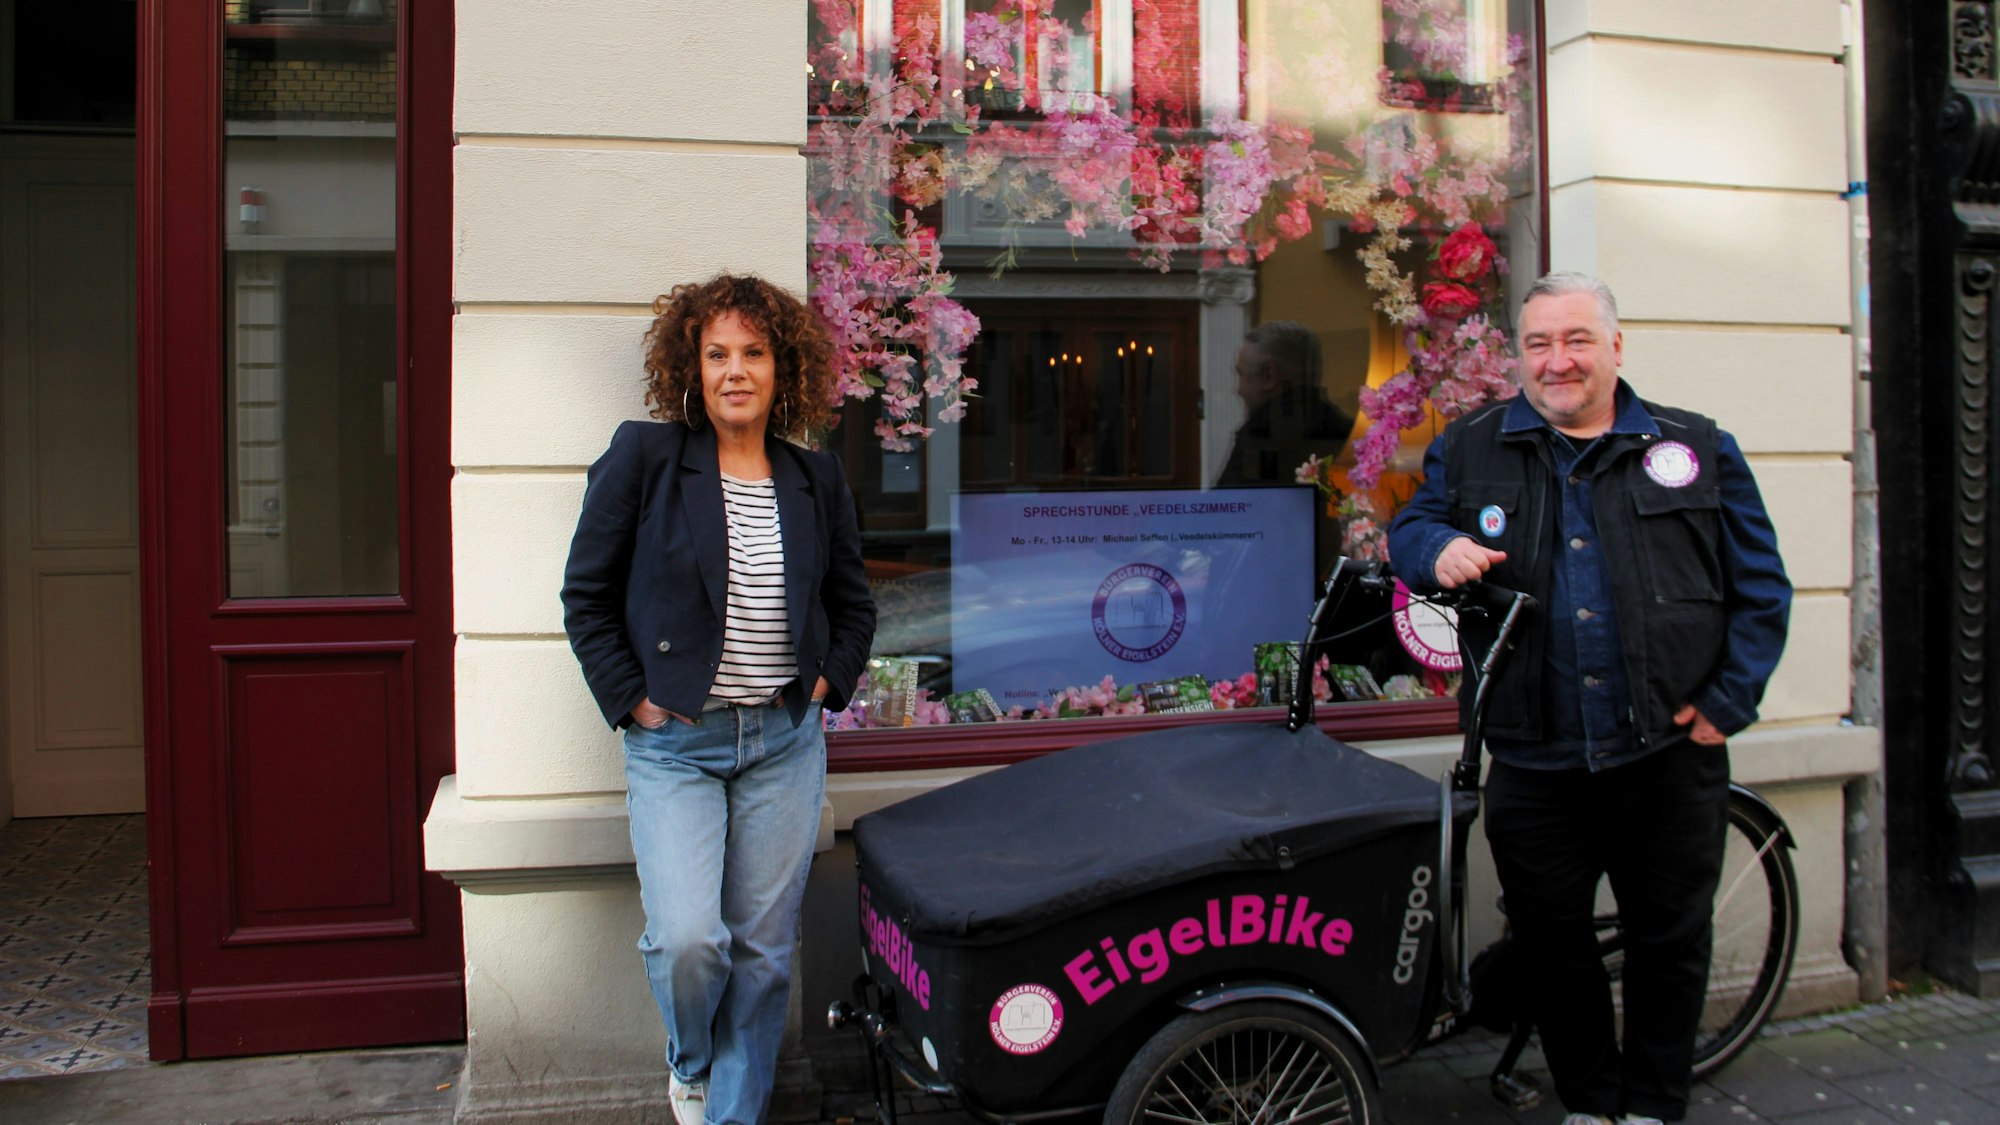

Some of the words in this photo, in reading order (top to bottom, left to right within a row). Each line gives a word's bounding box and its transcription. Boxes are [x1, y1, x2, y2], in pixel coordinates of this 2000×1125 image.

[1023, 505, 1130, 518] SPRECHSTUNDE
[1011, 536, 1026, 545] Mo
[1051, 535, 1076, 544] 13-14
[1078, 535, 1097, 544] Uhr:
[1103, 533, 1138, 543] Michael
[1121, 632, 1179, 661] EIGELSTEIN
[1394, 609, 1429, 662] KÖLNER
[1004, 689, 1041, 699] Hotline:
[1393, 864, 1433, 985] cargoo
[860, 883, 931, 1011] EigelBike
[1062, 894, 1354, 1006] EigelBike
[996, 984, 1058, 1009] BÜRGERVEREIN
[990, 1020, 1012, 1050] KÖLNER
[1011, 1031, 1055, 1053] EIGELSTEIN
